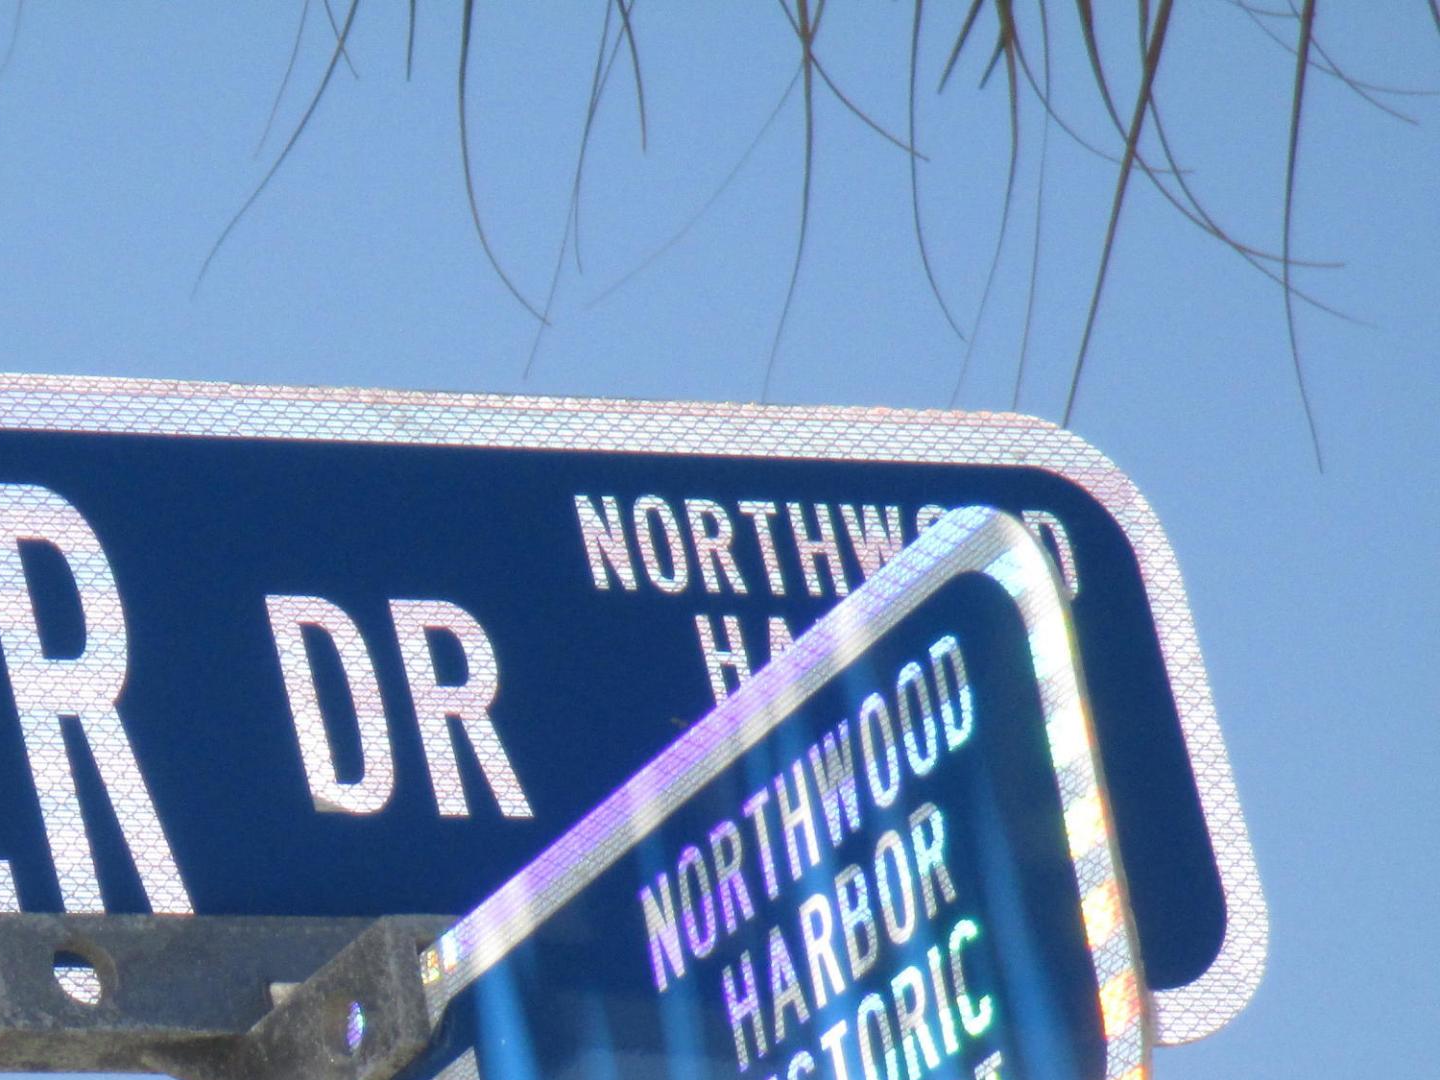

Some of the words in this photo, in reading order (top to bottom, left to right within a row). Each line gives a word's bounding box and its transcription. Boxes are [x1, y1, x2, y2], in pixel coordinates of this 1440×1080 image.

[574, 494, 1078, 598] NORTHWD
[264, 594, 533, 820] DR
[639, 634, 974, 992] NORTHWOOD
[723, 803, 956, 1071] HARBOR
